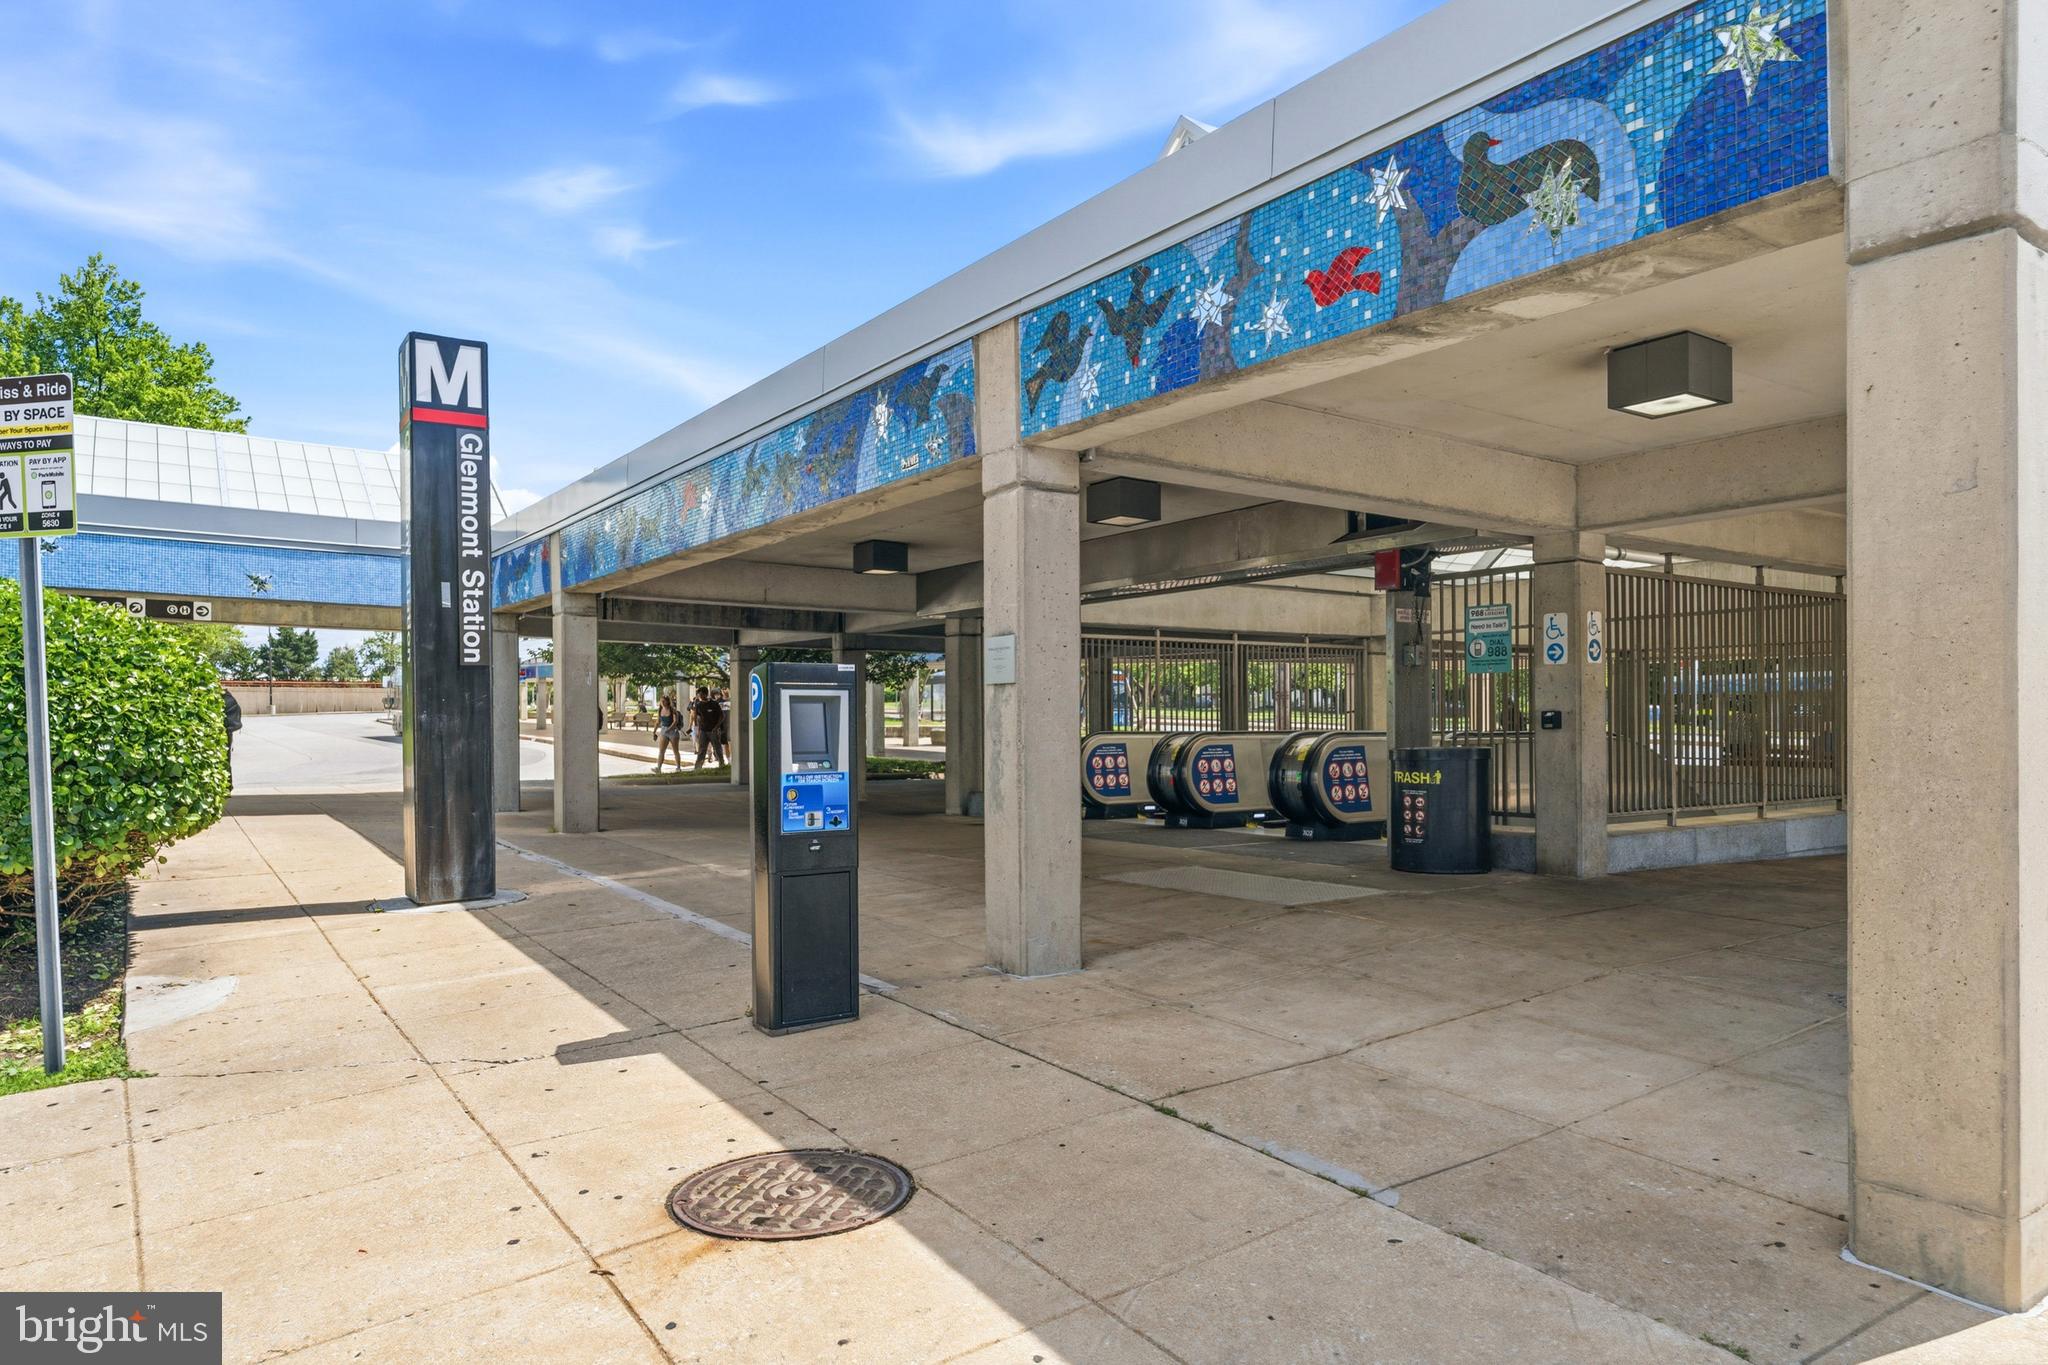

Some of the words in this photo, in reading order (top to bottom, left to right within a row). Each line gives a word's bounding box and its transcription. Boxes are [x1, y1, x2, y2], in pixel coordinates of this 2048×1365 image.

[414, 338, 482, 409] M
[0, 386, 19, 399] iss
[23, 384, 33, 398] &
[37, 382, 67, 397] Ride
[4, 409, 20, 422] BY
[24, 406, 65, 420] SPACE
[24, 426, 44, 435] Space
[45, 424, 69, 432] Number
[0, 440, 22, 451] WAYS
[23, 440, 35, 449] TO
[37, 438, 52, 448] PAY
[0, 459, 19, 467] ATION
[29, 457, 42, 465] PAY
[53, 456, 67, 464] APP
[459, 433, 484, 558] Glenmont
[461, 569, 486, 663] Station
[1471, 609, 1484, 617] 988
[1487, 646, 1508, 657] 988
[1393, 770, 1430, 784] TRASH
